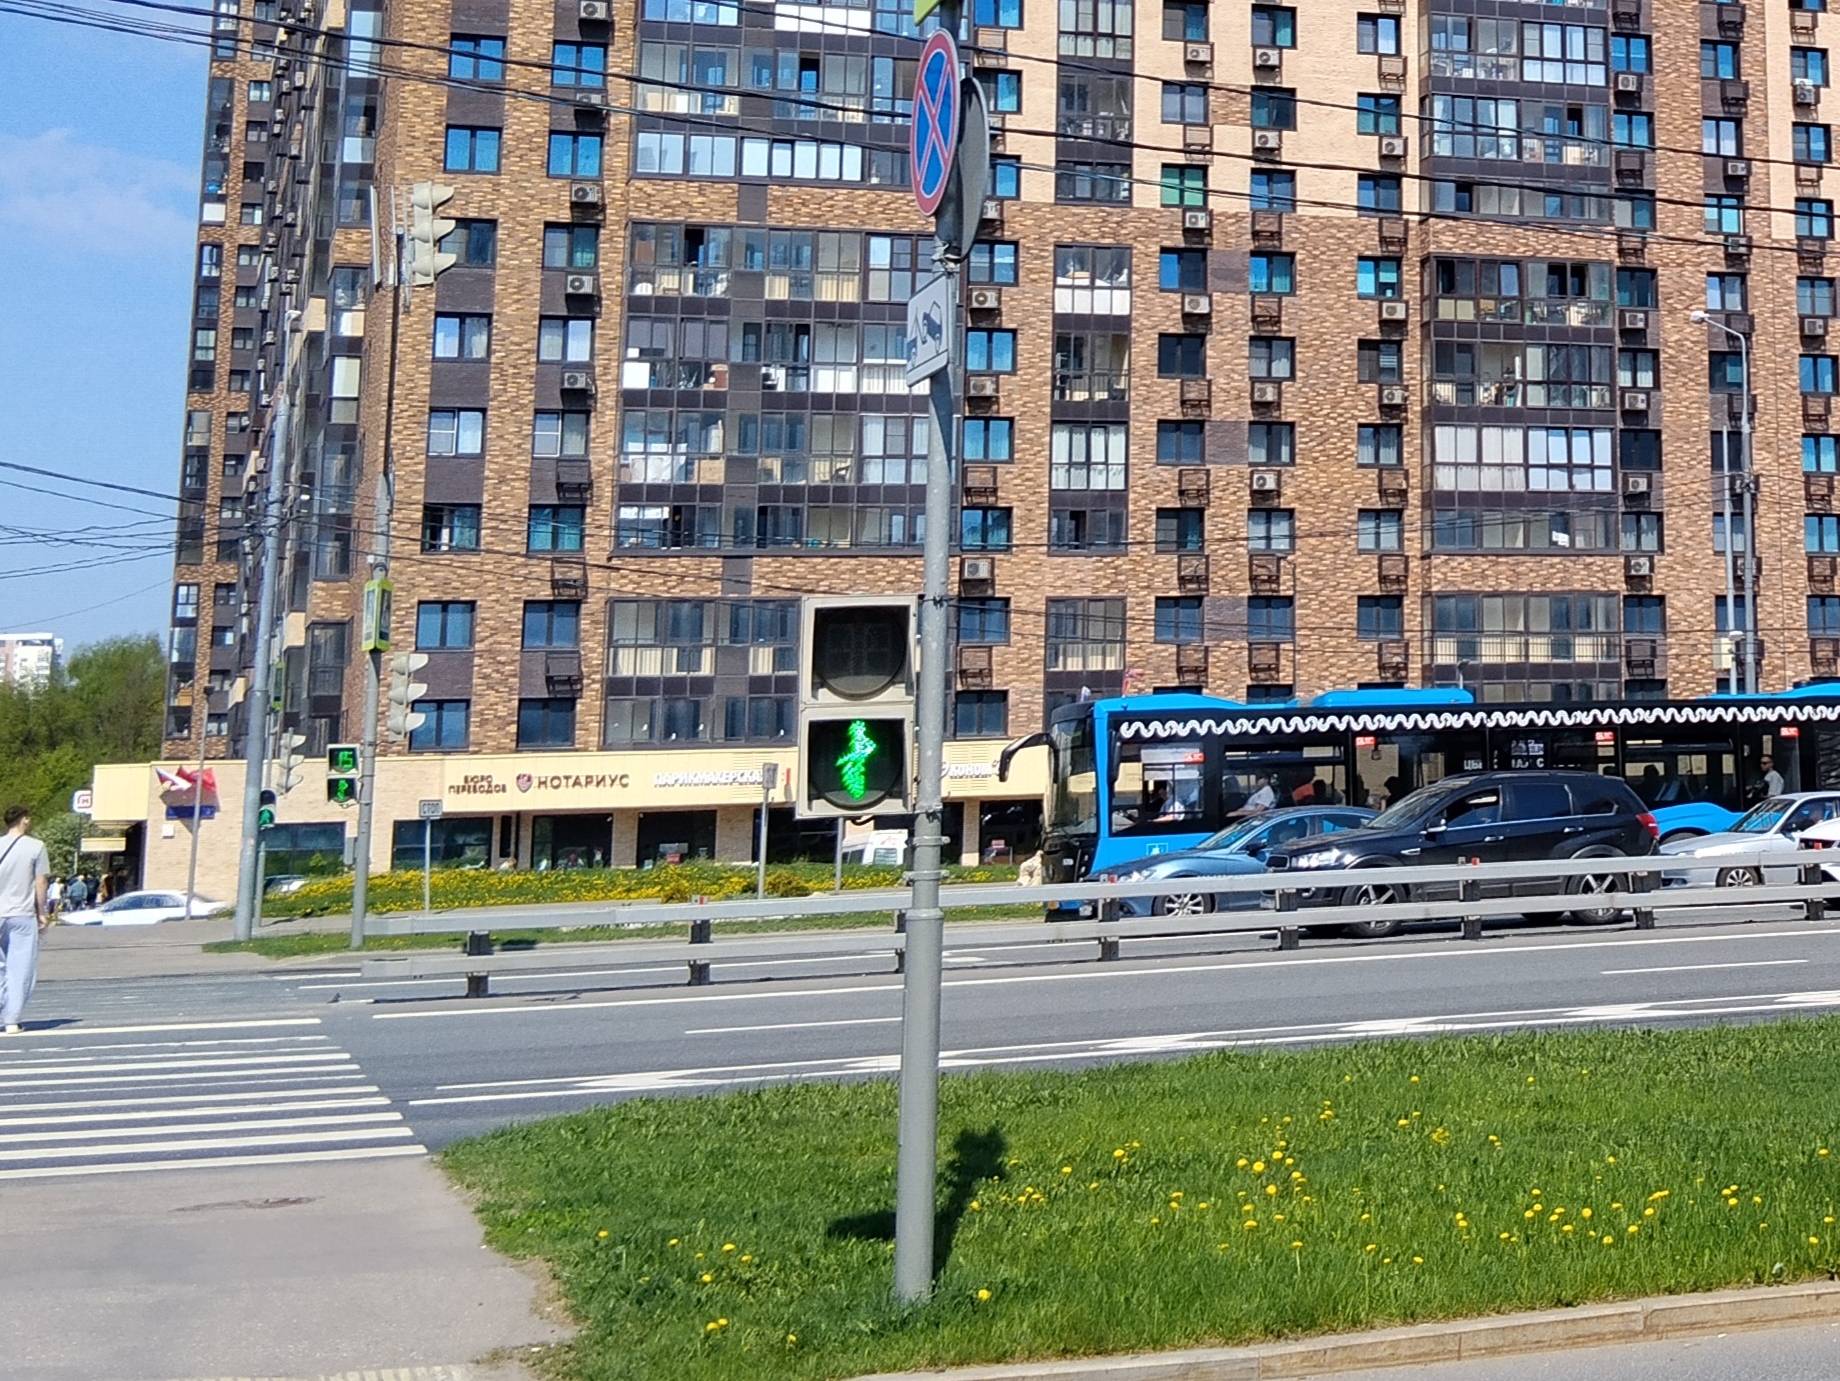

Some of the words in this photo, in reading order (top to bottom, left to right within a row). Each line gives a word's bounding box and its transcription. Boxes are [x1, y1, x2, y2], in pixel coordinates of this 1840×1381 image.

[463, 774, 494, 785] БЮРО
[537, 773, 630, 790] НОТАРИУС
[653, 769, 764, 788] ПАРИКМАХЕРСКА
